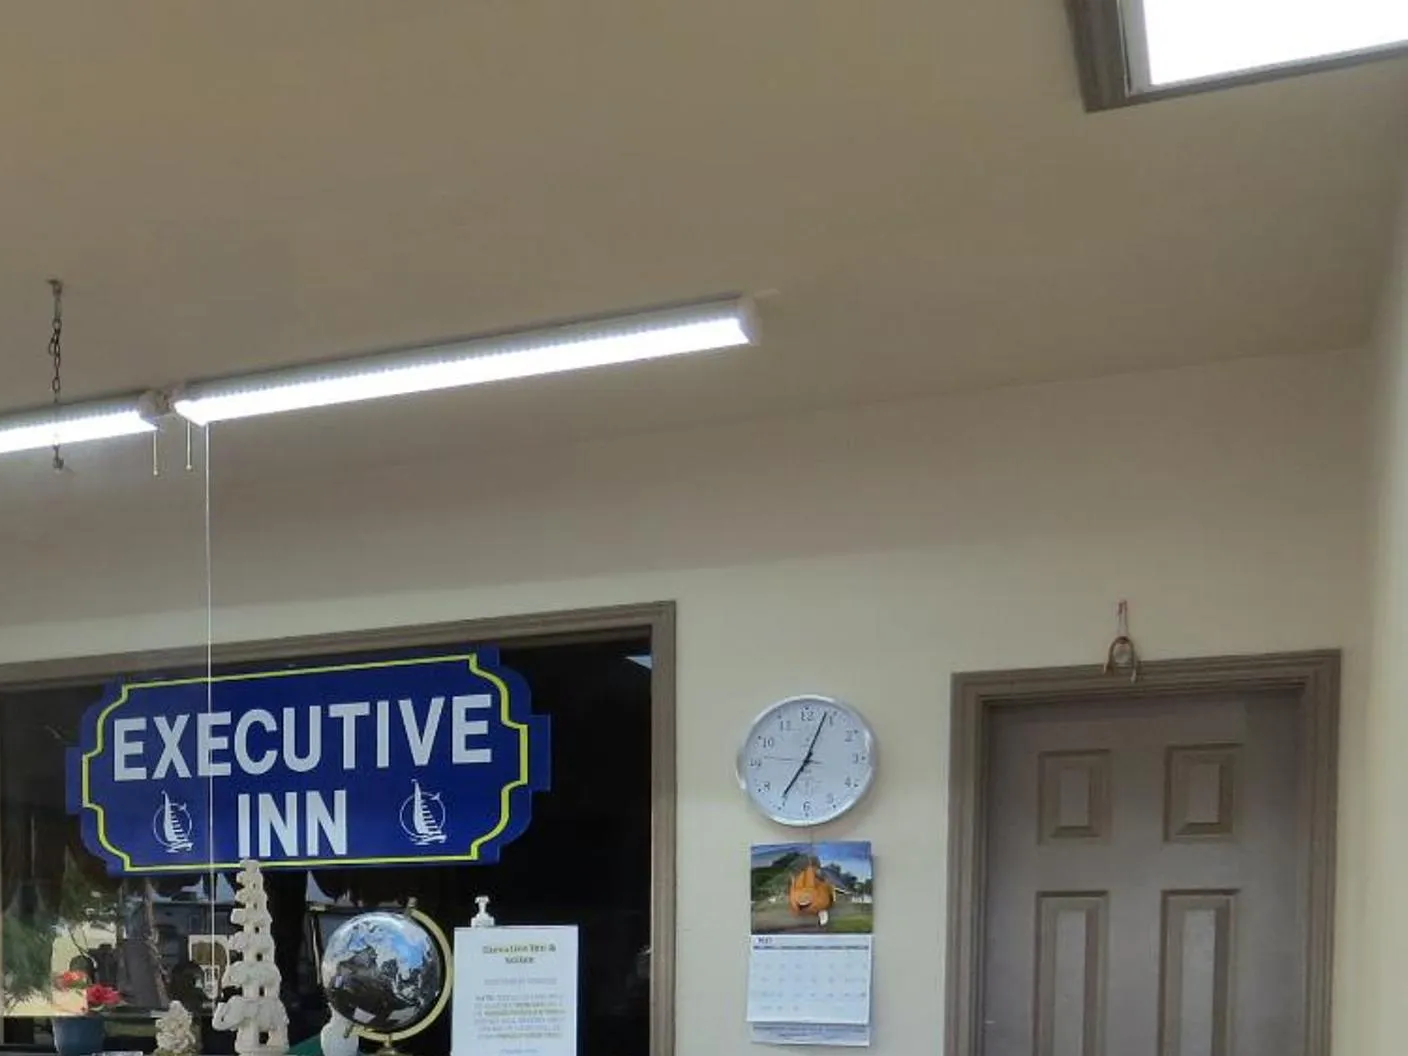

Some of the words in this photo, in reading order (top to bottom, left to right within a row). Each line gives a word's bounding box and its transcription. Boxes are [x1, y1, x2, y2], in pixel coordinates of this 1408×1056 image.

[800, 710, 814, 721] 12
[113, 694, 493, 782] EXECUTIVE
[762, 738, 774, 748] 10
[237, 790, 348, 859] INN
